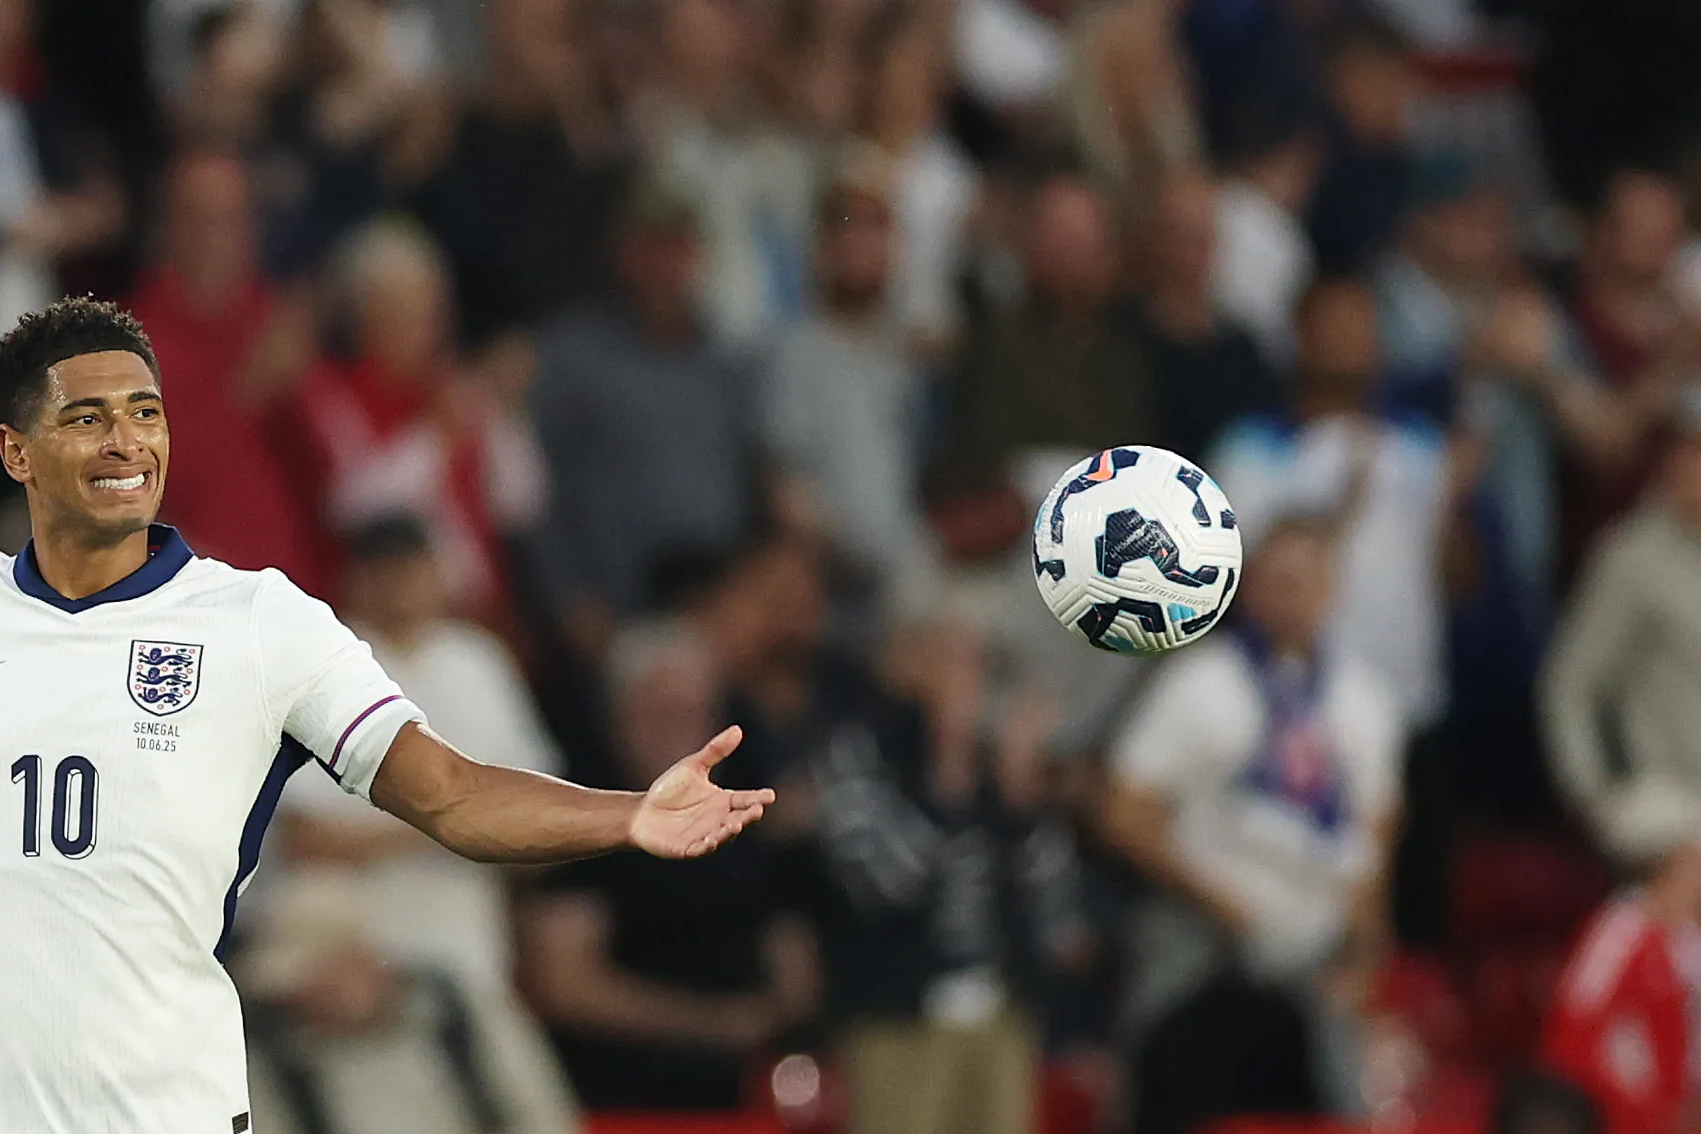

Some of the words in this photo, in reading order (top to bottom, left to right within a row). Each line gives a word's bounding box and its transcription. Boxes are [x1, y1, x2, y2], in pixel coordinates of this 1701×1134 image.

[133, 721, 181, 738] SENEGAL
[136, 737, 176, 752] 10.06.25
[11, 754, 99, 860] 10
